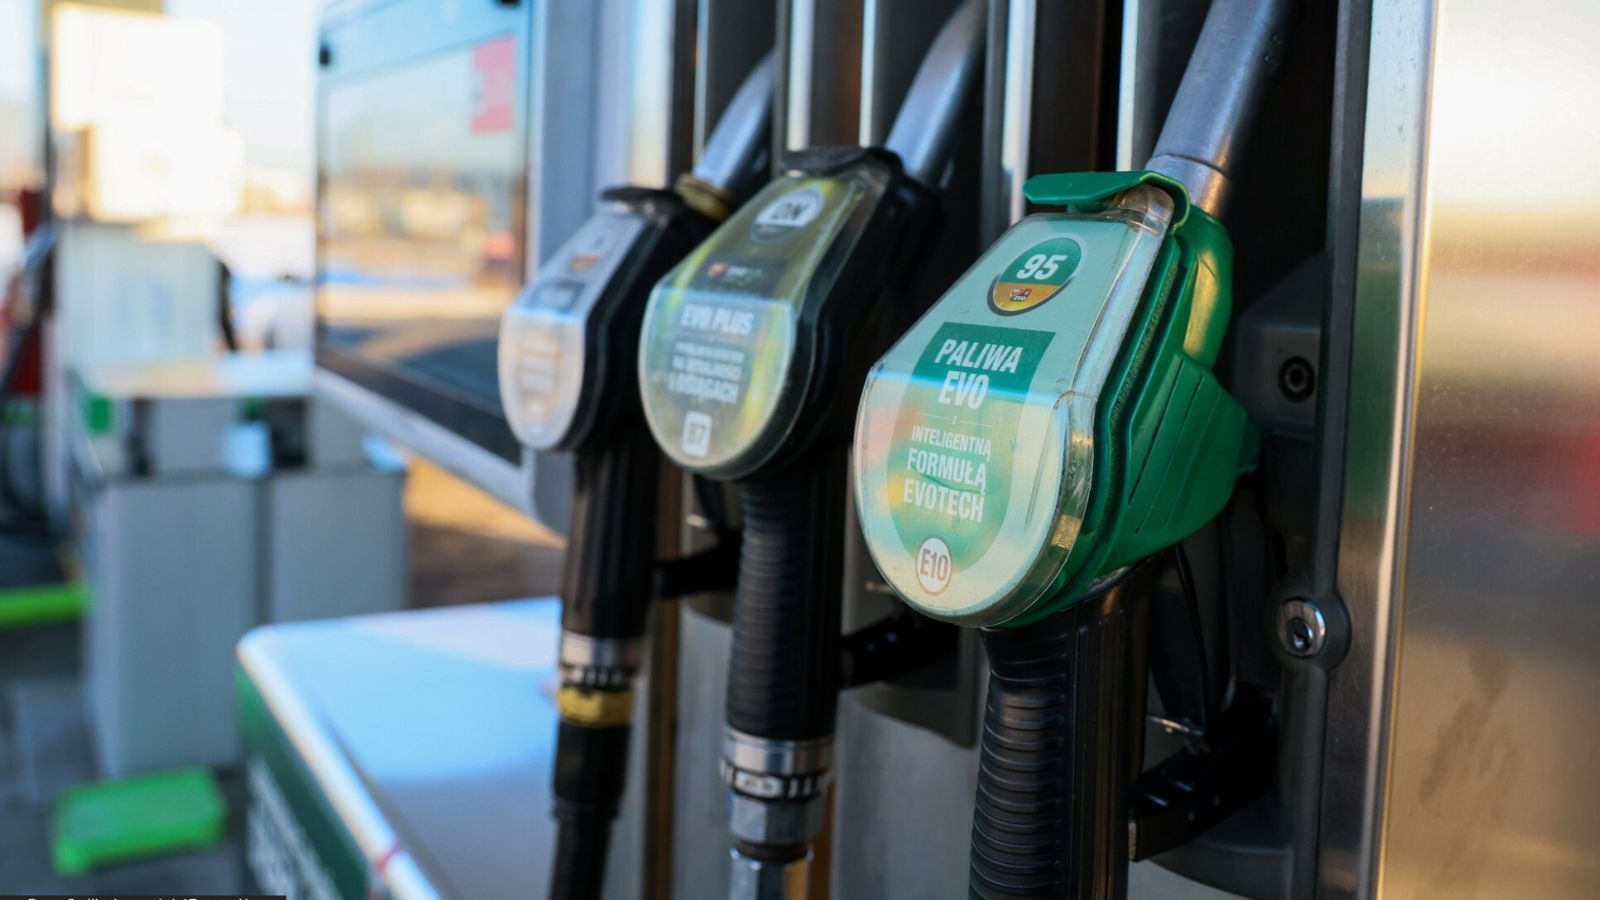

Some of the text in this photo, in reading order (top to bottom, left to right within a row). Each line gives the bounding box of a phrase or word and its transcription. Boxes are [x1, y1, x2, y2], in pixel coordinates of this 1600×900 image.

[1016, 253, 1068, 280] 95
[680, 303, 754, 336] EVO PLUS
[934, 339, 1023, 373] PALIWA
[938, 370, 990, 410] EVO
[911, 424, 992, 462] INTELIGENTNĄ
[907, 447, 987, 496] FORMUŁĄ
[903, 478, 985, 522] EVOTECH
[920, 548, 949, 580] E10
